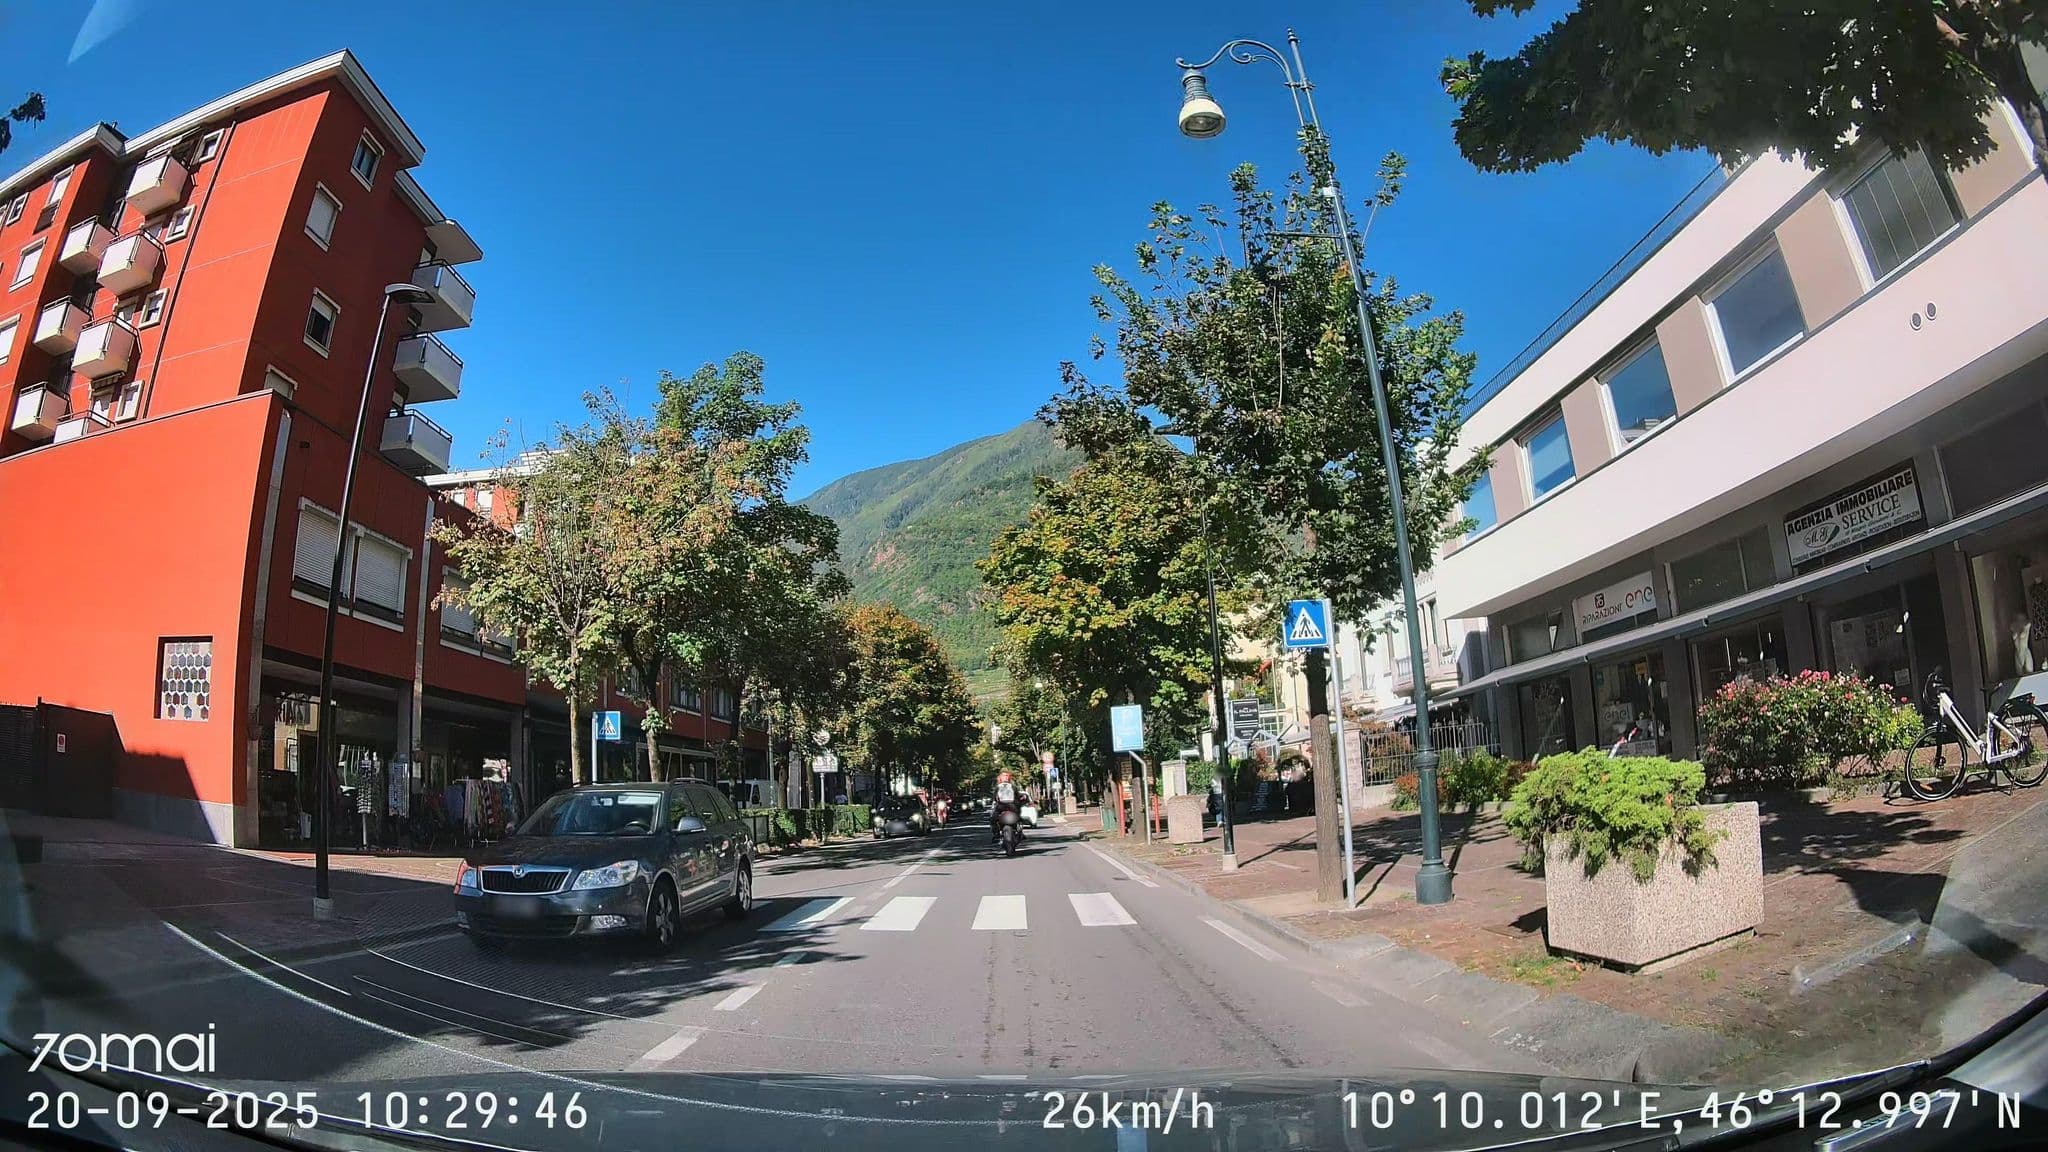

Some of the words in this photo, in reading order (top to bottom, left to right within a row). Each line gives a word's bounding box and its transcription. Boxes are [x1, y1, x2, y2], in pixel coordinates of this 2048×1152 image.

[1788, 508, 1833, 536] AGENZIA
[1836, 471, 1913, 515] IMMOBILIARE
[1841, 493, 1901, 530] SERVICE
[1625, 586, 1653, 609] ene
[1582, 603, 1623, 625] RIPARAZIONI
